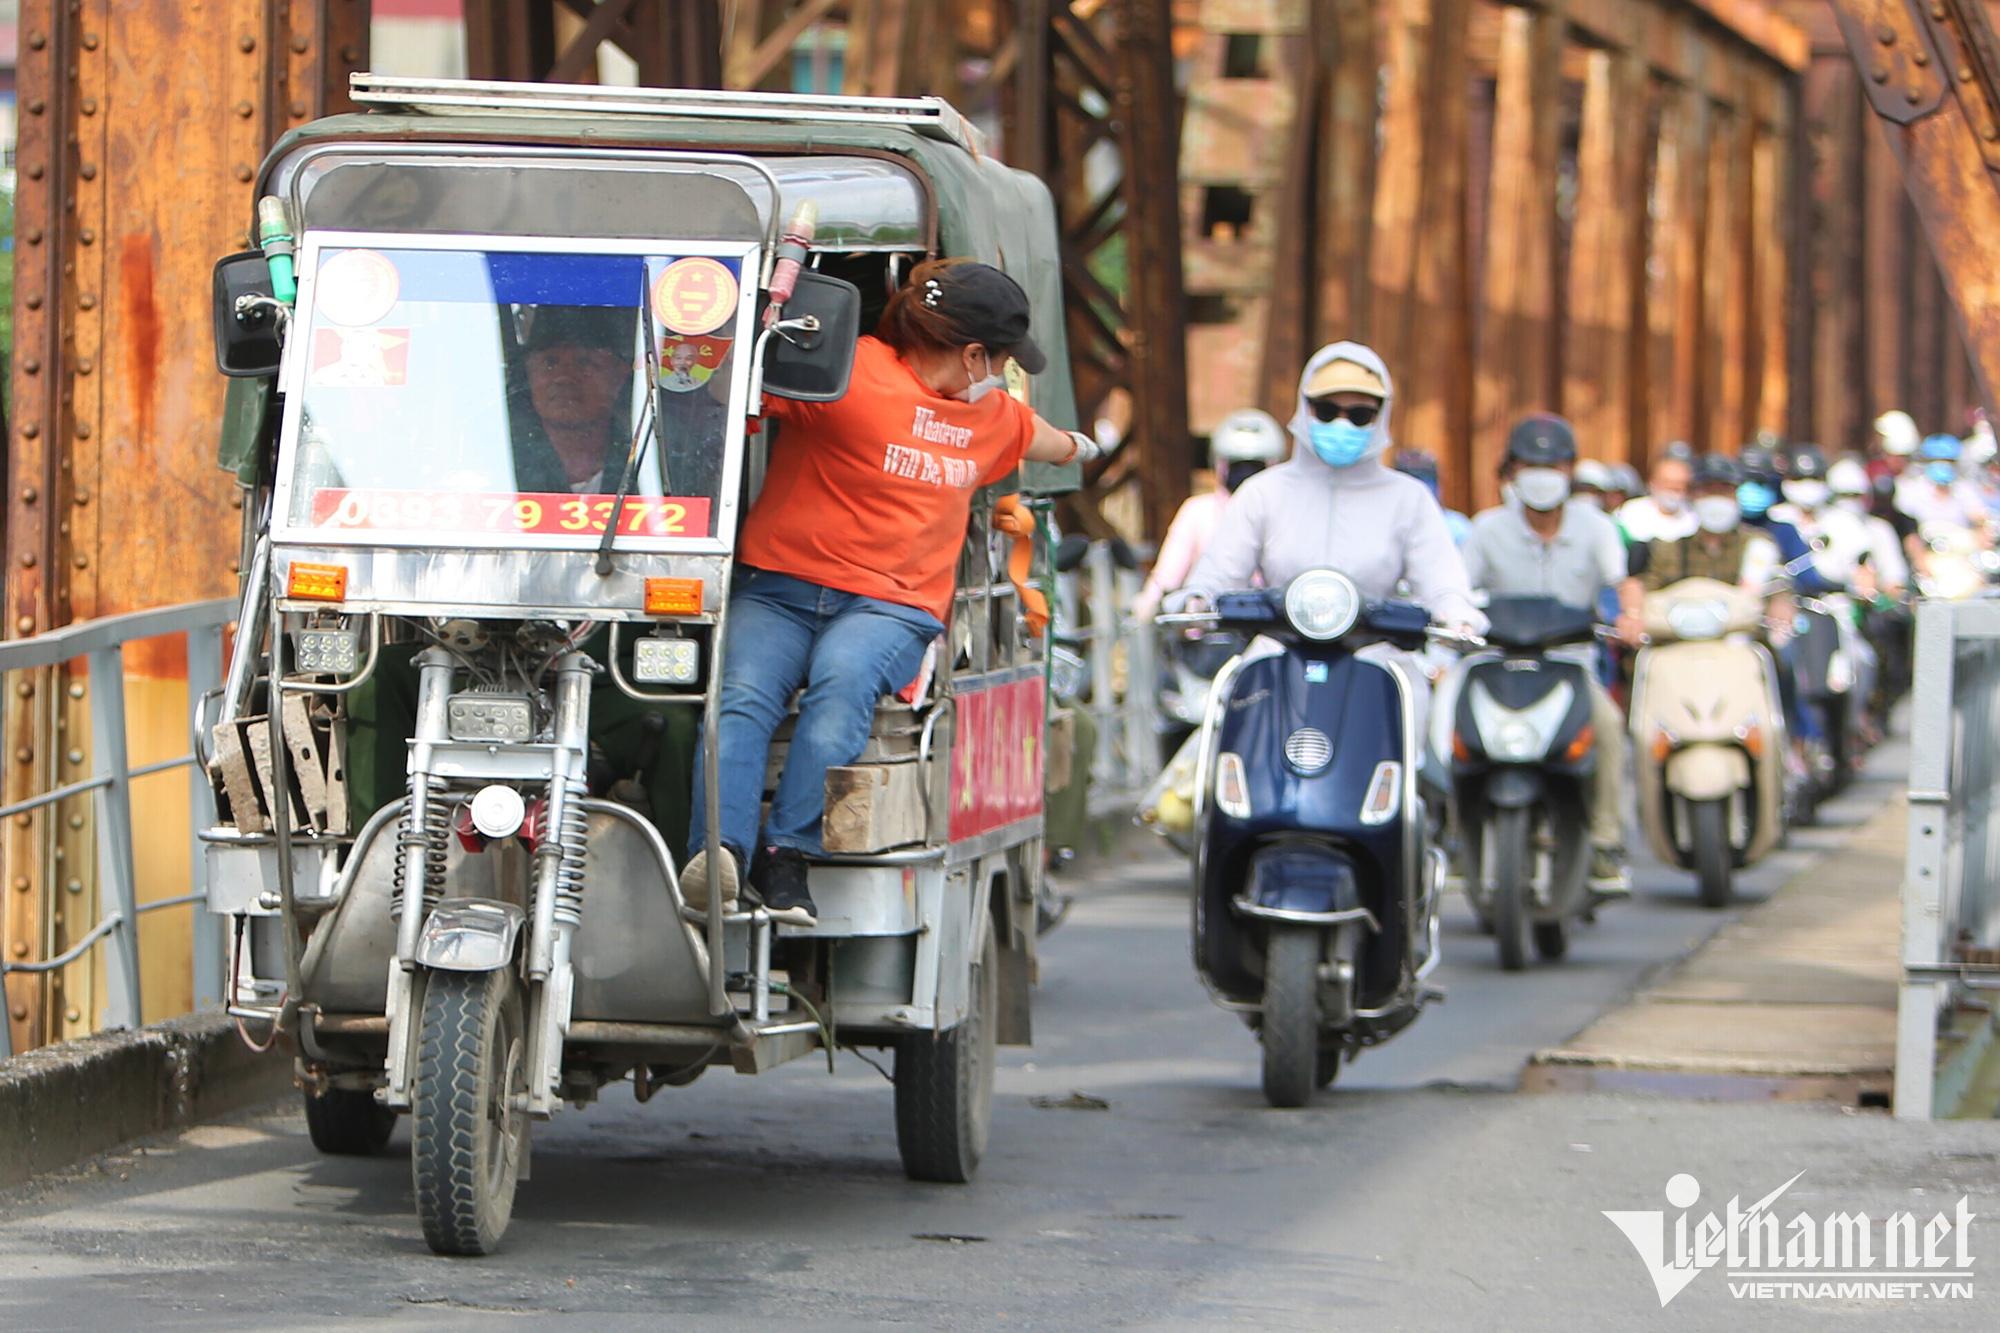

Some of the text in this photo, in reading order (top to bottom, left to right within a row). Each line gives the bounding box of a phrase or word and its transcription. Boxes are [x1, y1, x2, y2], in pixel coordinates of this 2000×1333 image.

[912, 405, 974, 449] Whatever
[883, 443, 921, 479] Will
[481, 498, 543, 530] 79
[559, 500, 687, 533] 3372
